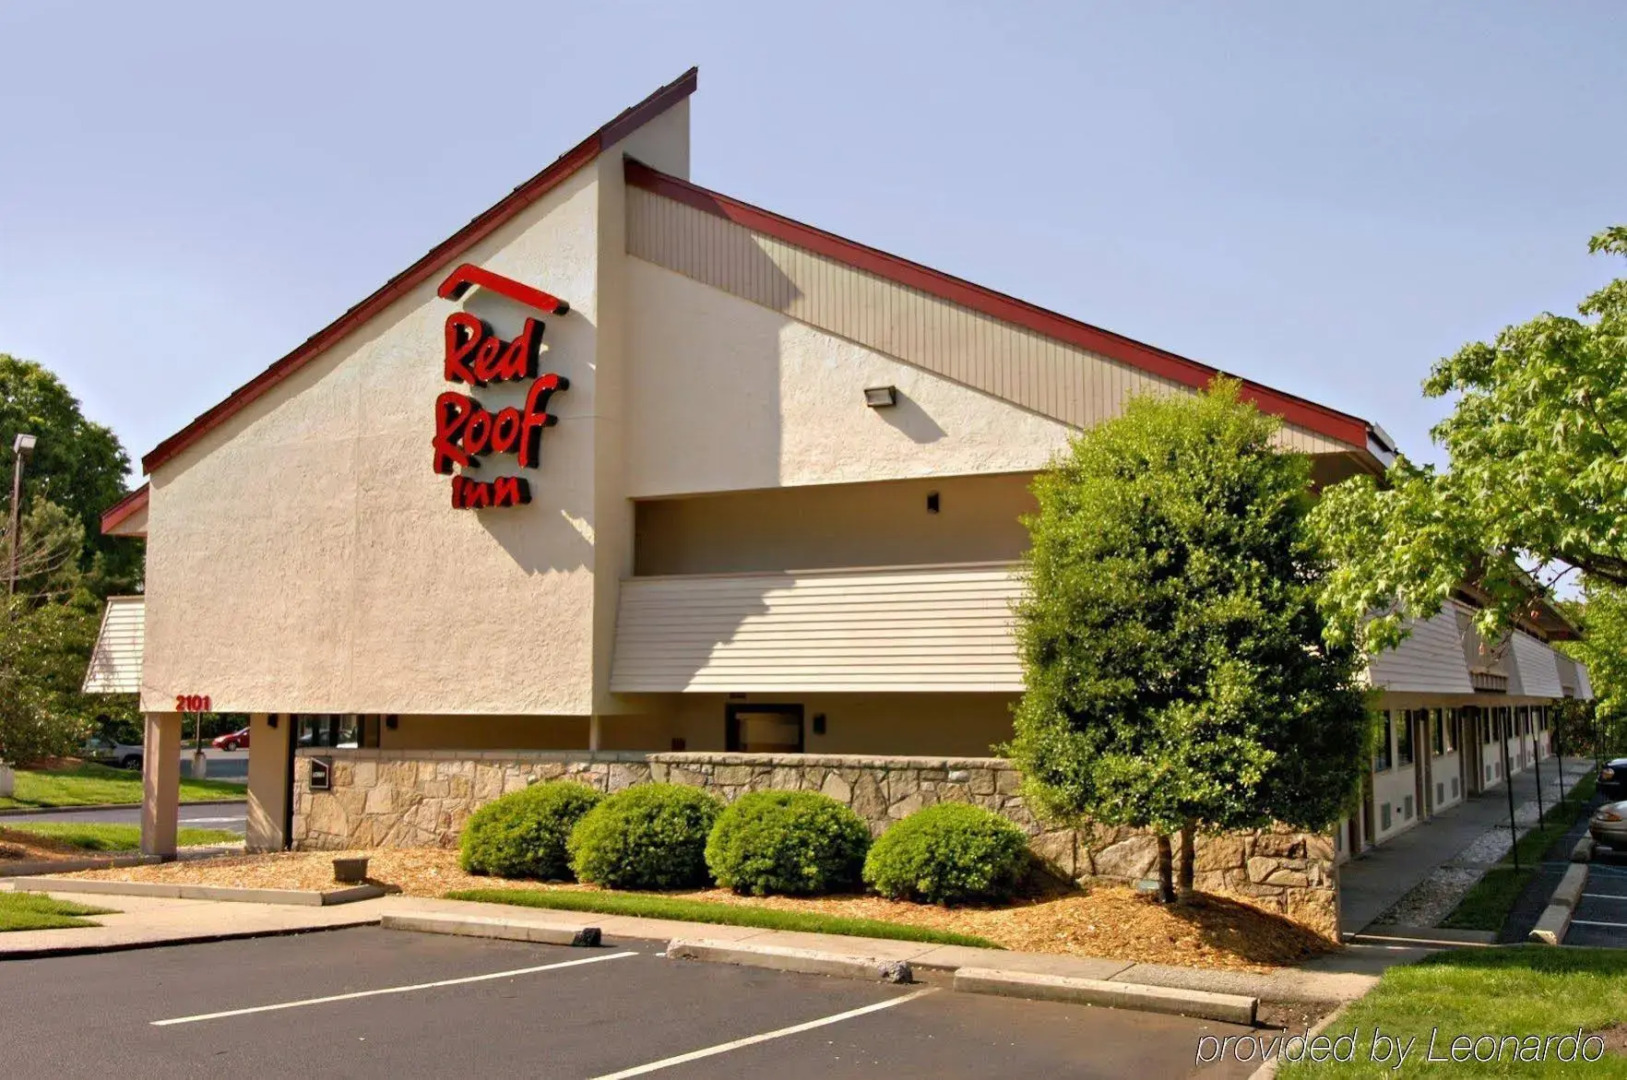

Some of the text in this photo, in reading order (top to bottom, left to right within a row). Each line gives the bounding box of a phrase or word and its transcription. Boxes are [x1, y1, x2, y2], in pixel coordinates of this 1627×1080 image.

[444, 311, 545, 388] Red
[432, 373, 569, 475] Roof
[175, 694, 211, 712] 2101
